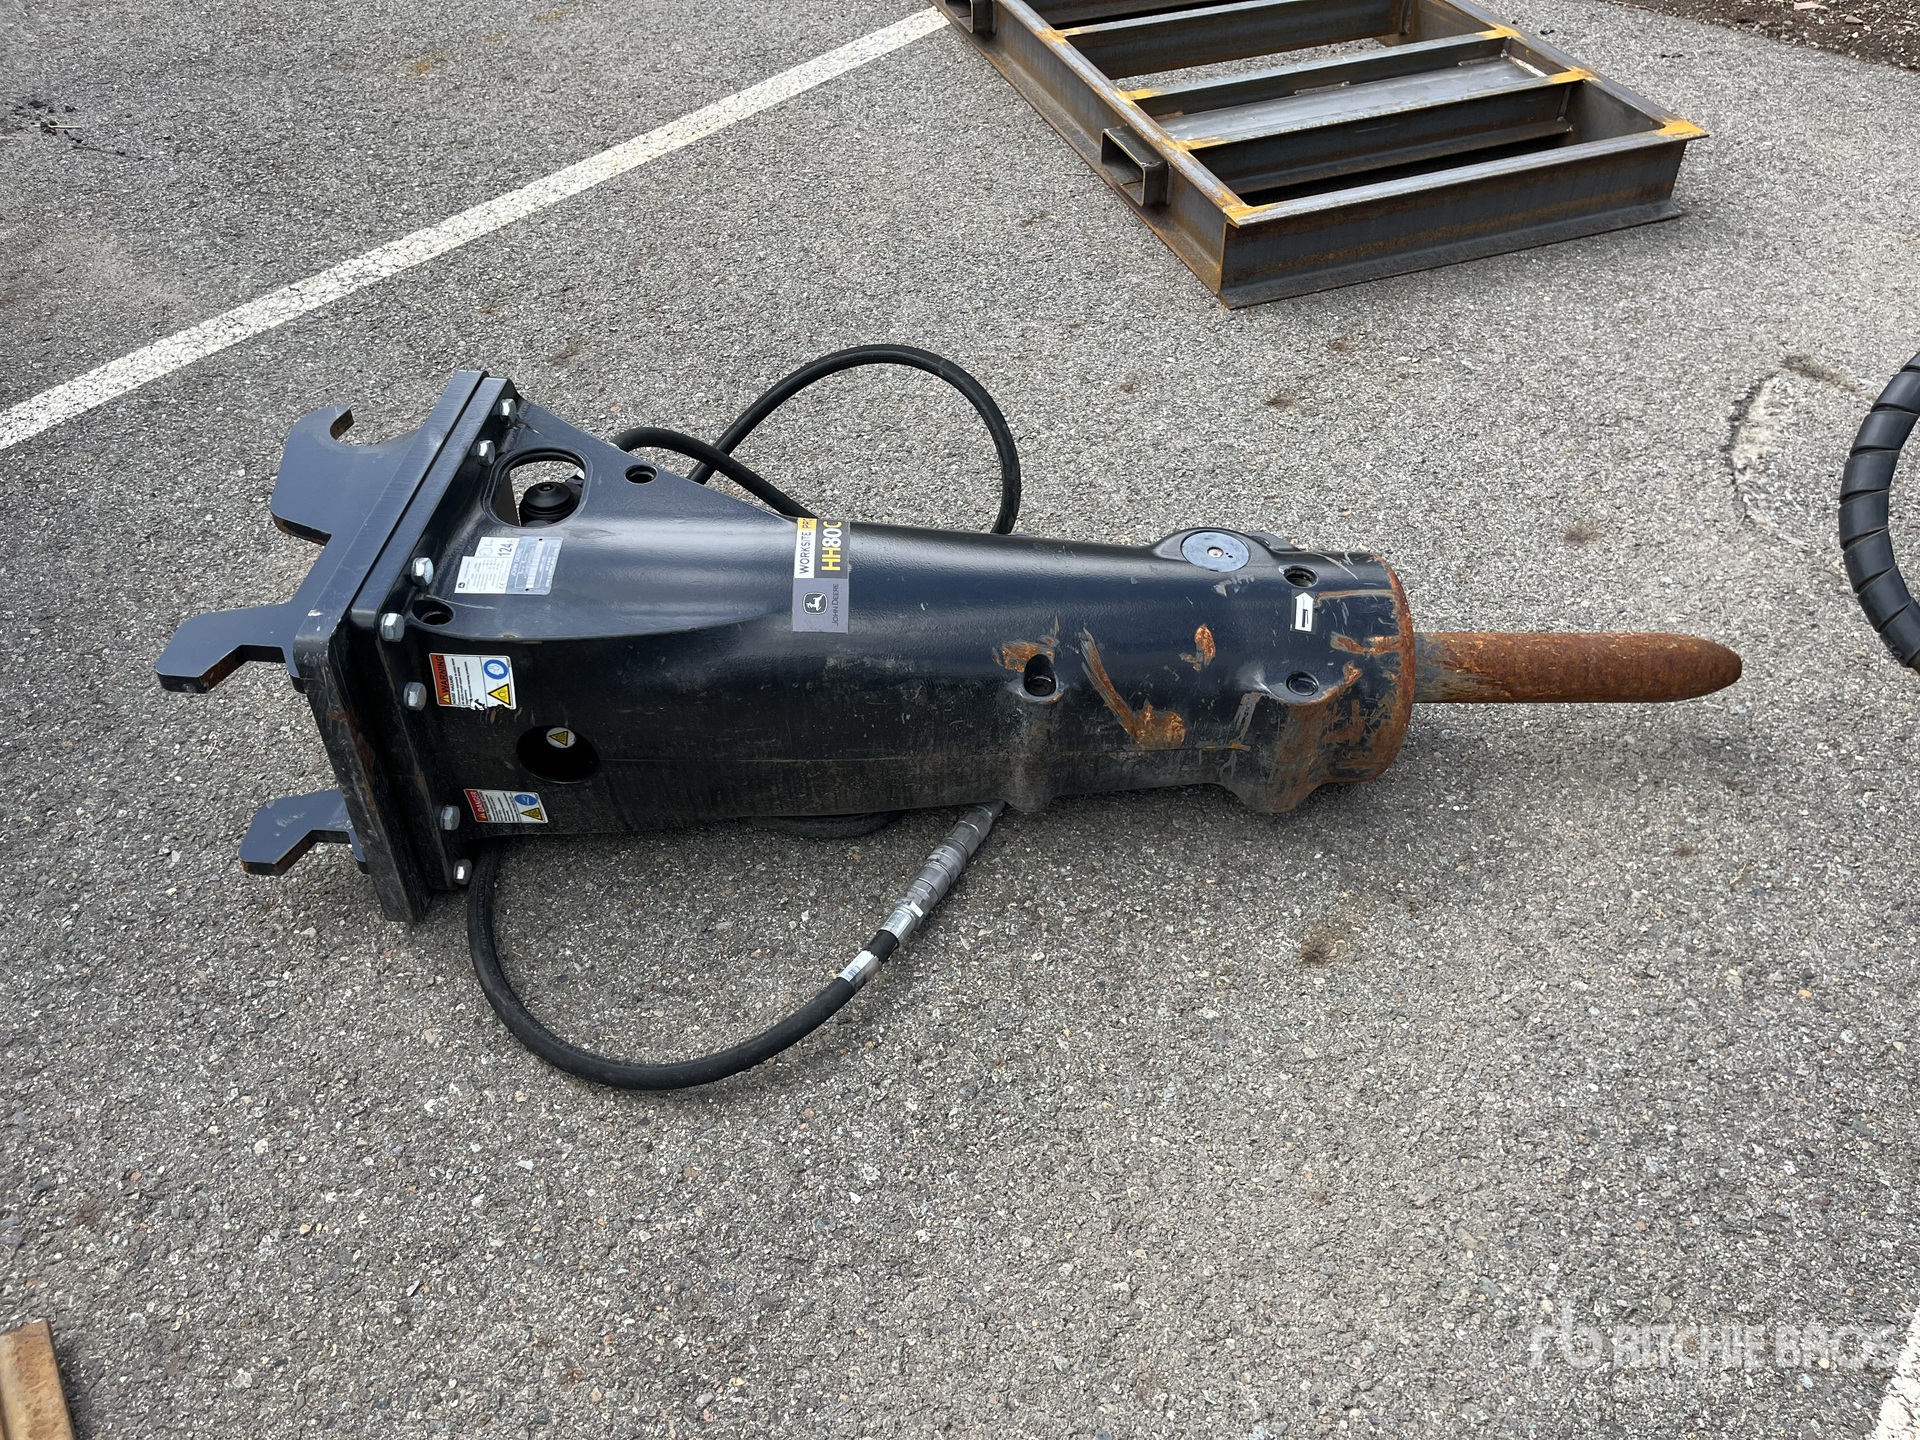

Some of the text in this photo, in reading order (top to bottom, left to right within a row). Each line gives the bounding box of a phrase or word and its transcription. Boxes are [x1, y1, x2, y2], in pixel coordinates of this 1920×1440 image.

[799, 531, 811, 574] WORKSITE
[511, 562, 520, 577] JOHN
[436, 655, 449, 693] WARNING
[470, 791, 485, 812] DANGER
